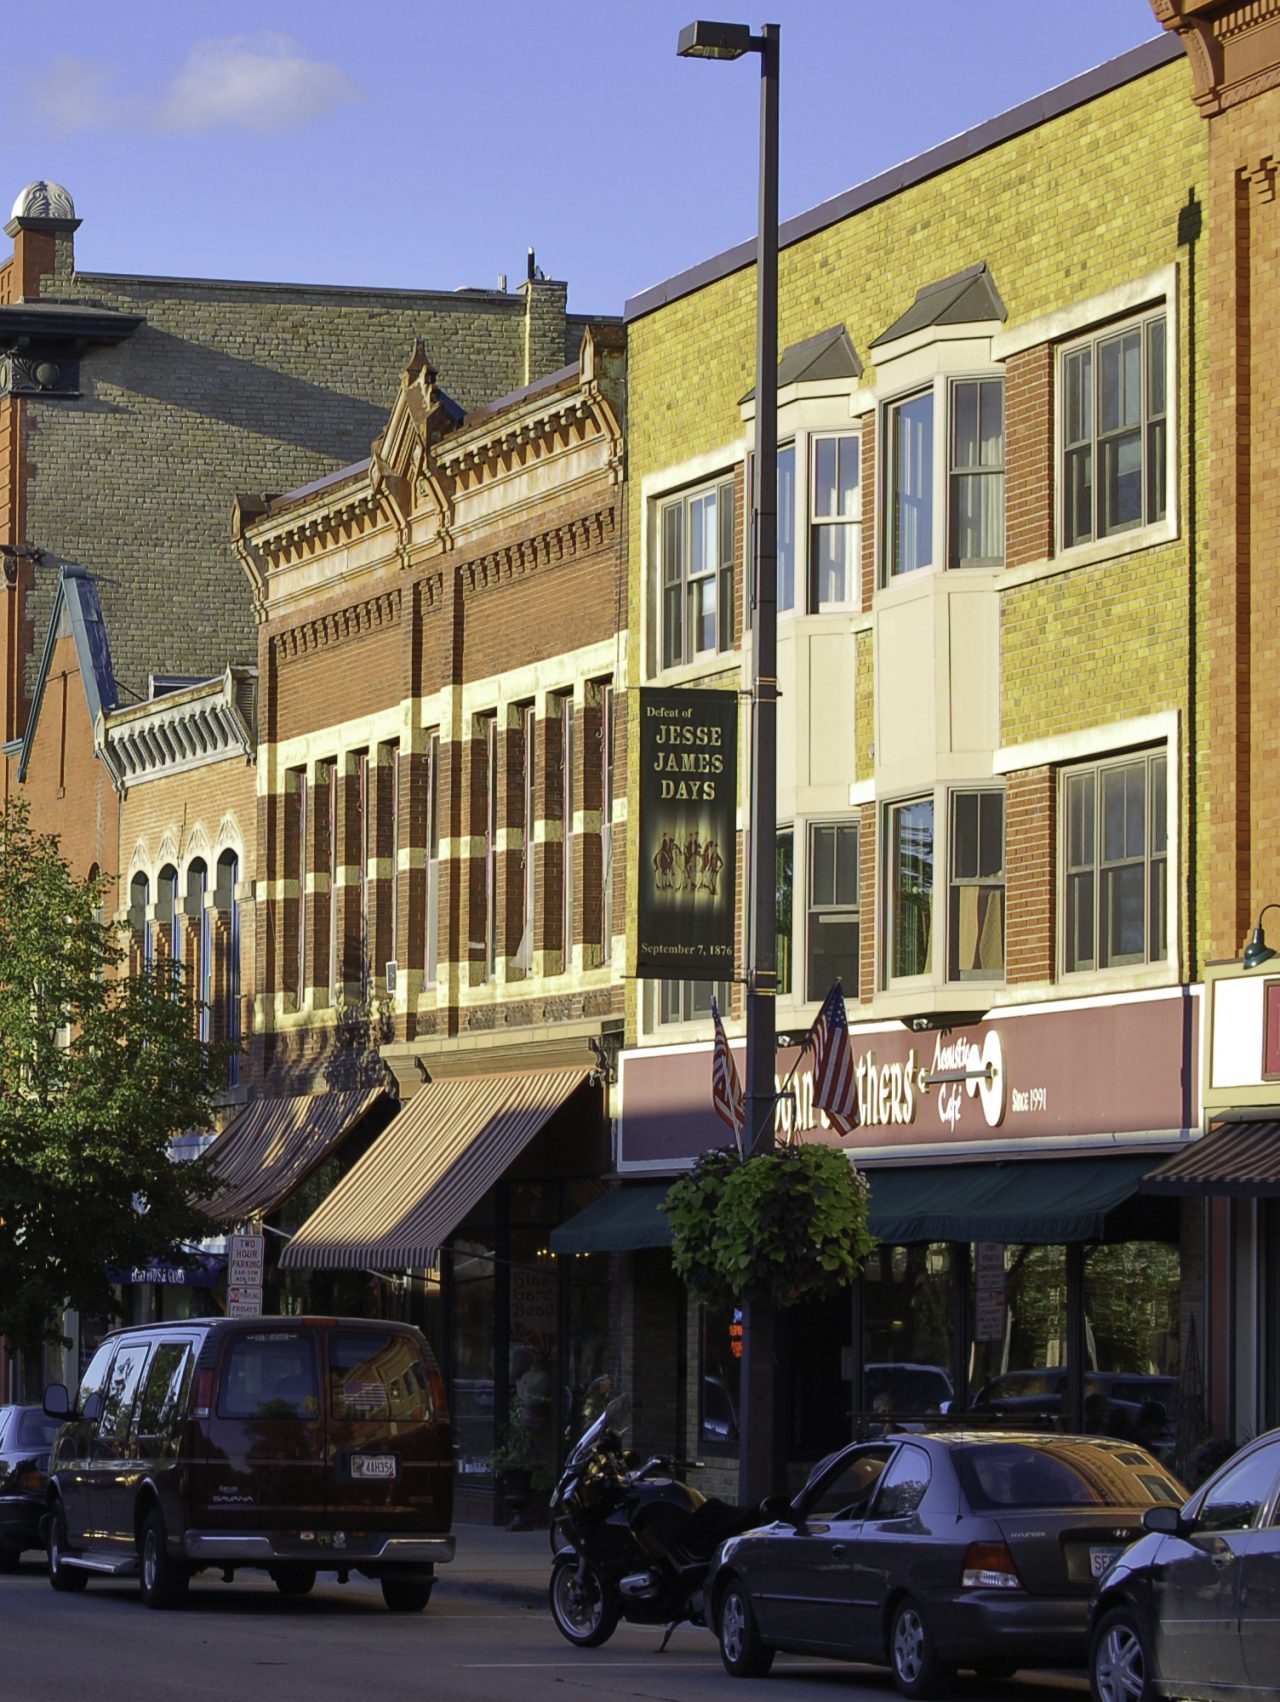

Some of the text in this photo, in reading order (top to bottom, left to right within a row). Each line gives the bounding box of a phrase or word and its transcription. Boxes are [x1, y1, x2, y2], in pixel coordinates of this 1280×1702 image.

[647, 706, 693, 719] Defeat of
[656, 725, 722, 746] JESSE
[653, 752, 724, 774] JAMES
[661, 780, 716, 801] DAYS
[641, 943, 733, 956] September 7, 1876
[1030, 1087, 1047, 1112] 1991
[239, 1239, 255, 1248] TWO
[236, 1250, 258, 1258] HOUR
[232, 1260, 261, 1269] PARKING
